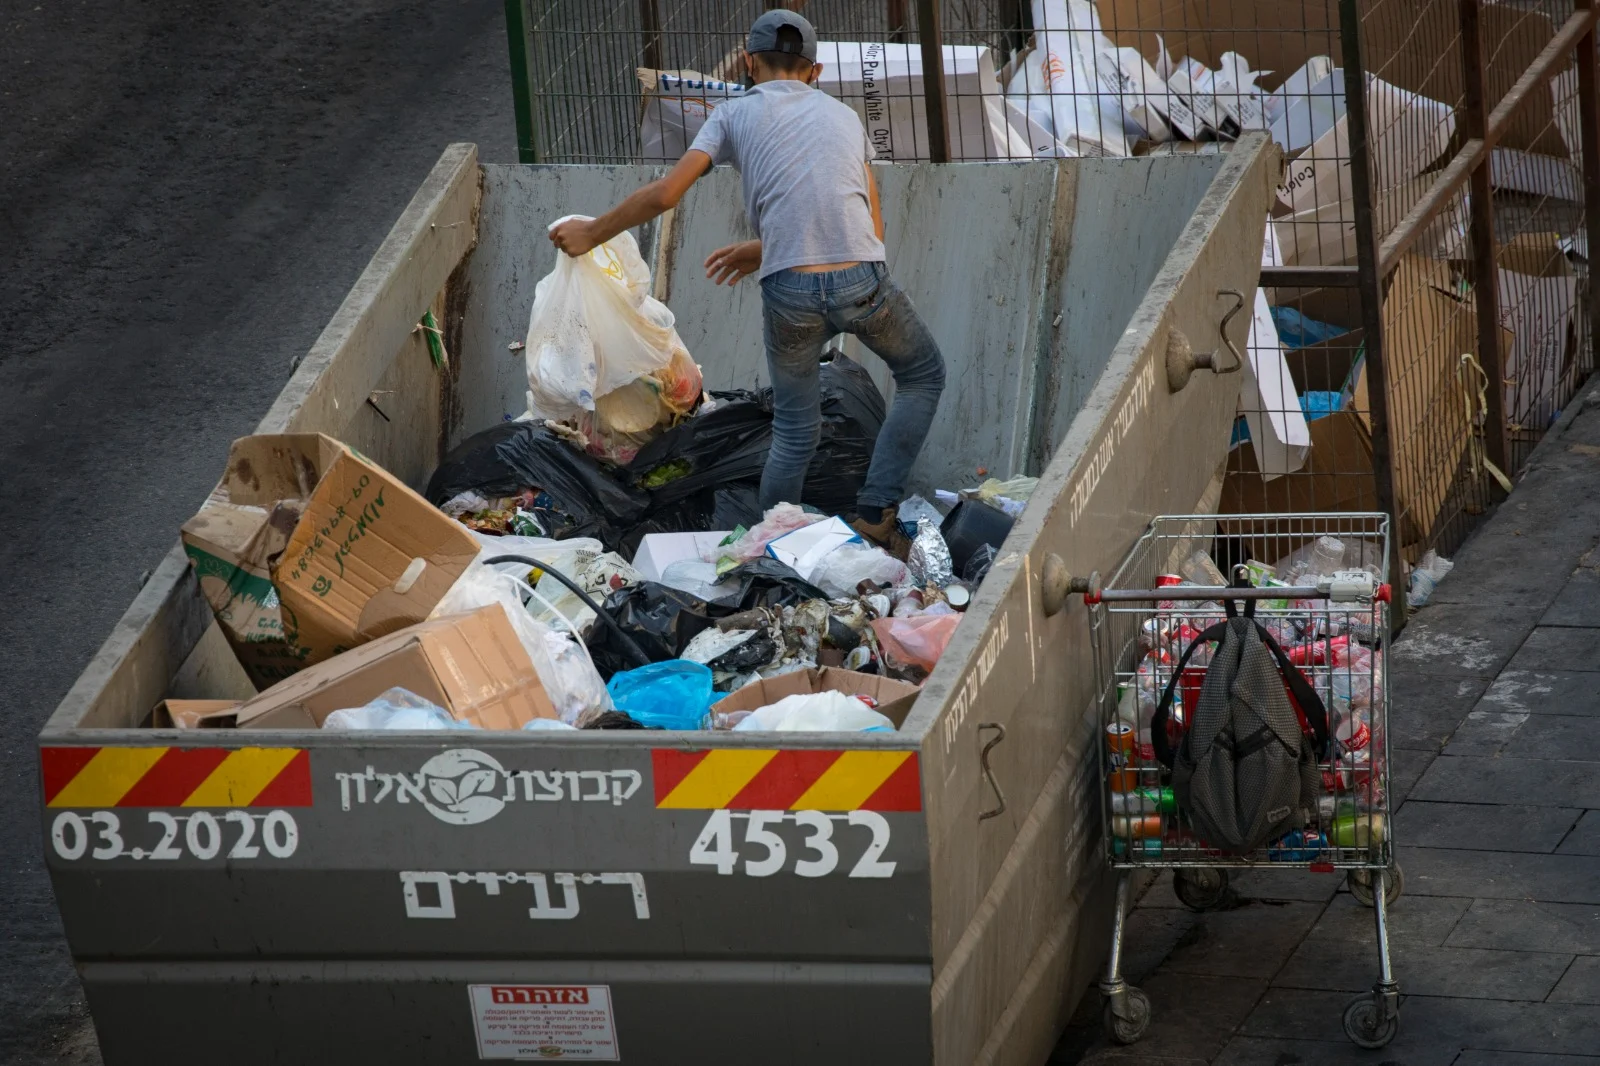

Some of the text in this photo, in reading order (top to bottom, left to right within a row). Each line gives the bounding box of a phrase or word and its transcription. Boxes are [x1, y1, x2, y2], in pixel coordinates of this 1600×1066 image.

[863, 61, 879, 88] Pure
[865, 90, 883, 121] White
[1280, 166, 1315, 197] Color:
[1100, 429, 1115, 476] אש
[1070, 453, 1100, 529] במכולה
[291, 475, 370, 580] 09-8943684
[335, 764, 643, 812] קבוצת אלון
[51, 809, 299, 861] 03.2020
[689, 808, 897, 878] 4532
[496, 988, 585, 1003] אזהרה
